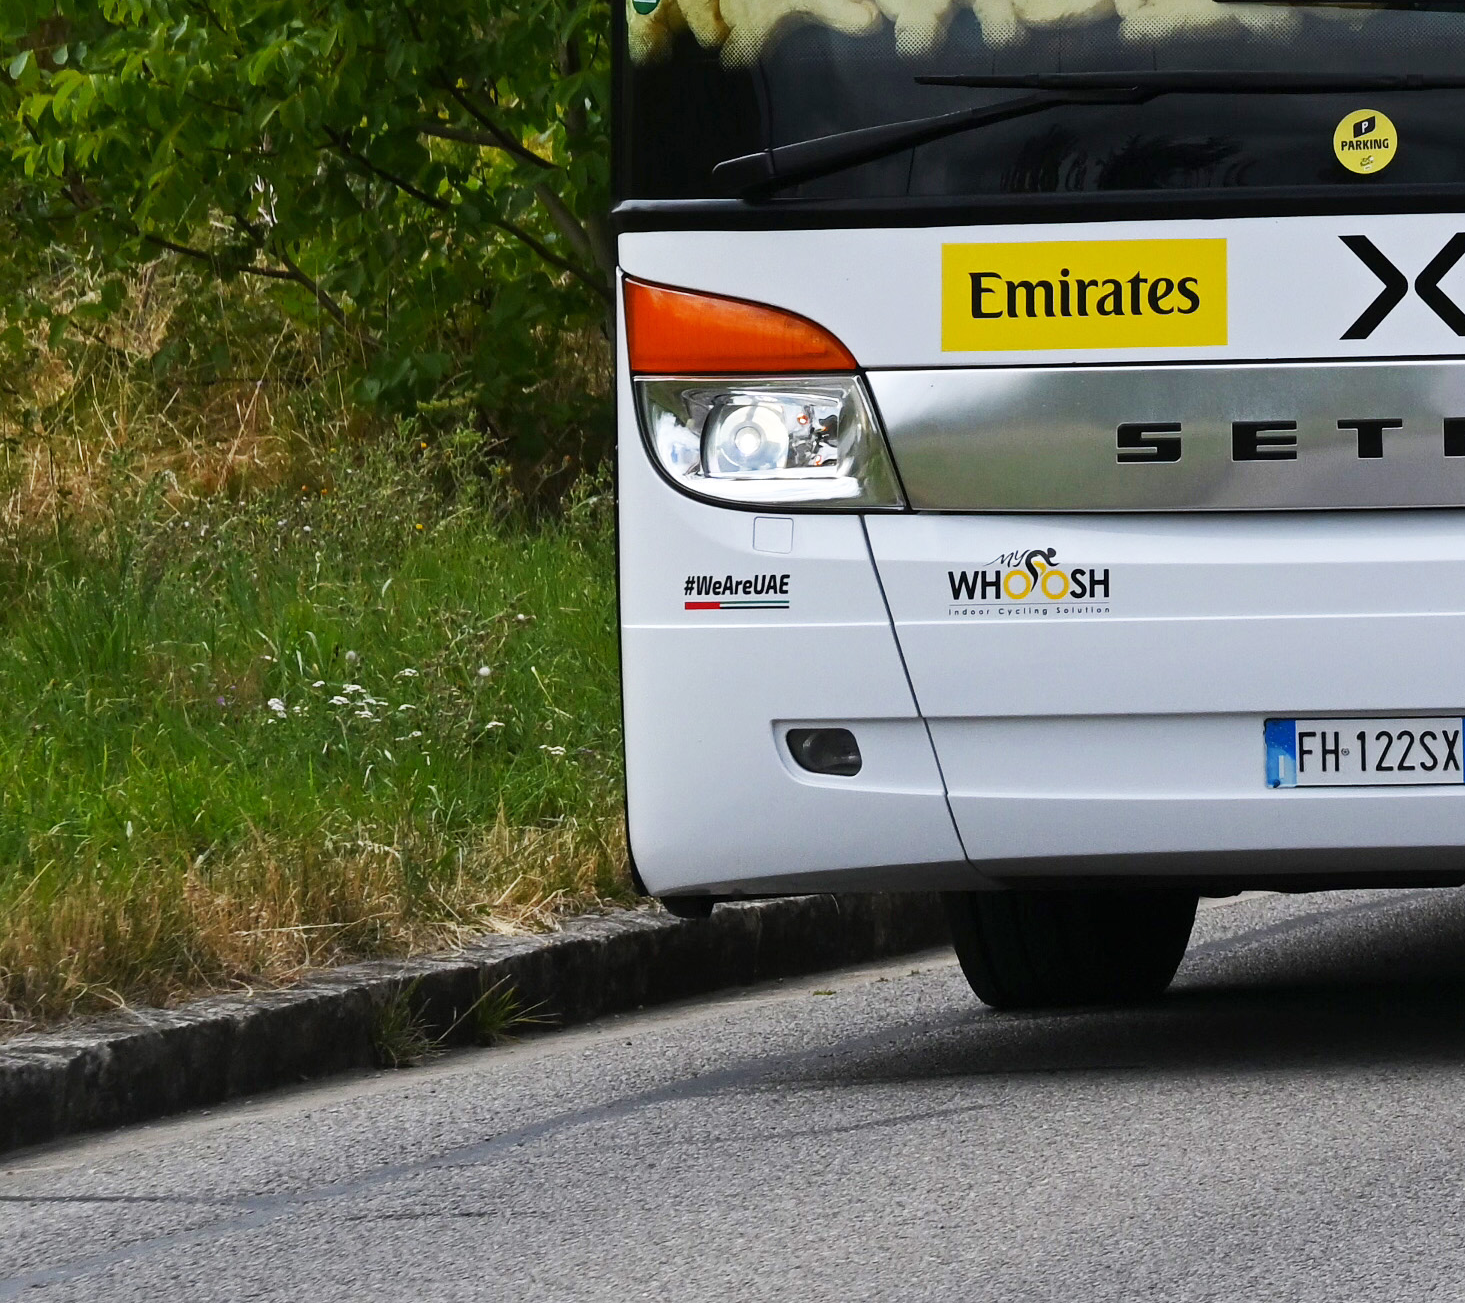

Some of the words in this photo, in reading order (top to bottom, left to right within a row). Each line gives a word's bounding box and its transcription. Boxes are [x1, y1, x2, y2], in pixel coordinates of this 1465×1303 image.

[1341, 138, 1389, 152] PARKING
[968, 267, 1202, 322] Emirates
[683, 574, 791, 597] #WeAreUAE
[947, 568, 1111, 601] WHOOSH
[948, 607, 991, 616] Indoor
[998, 606, 1049, 617] Cycling
[1056, 605, 1110, 615] Solution
